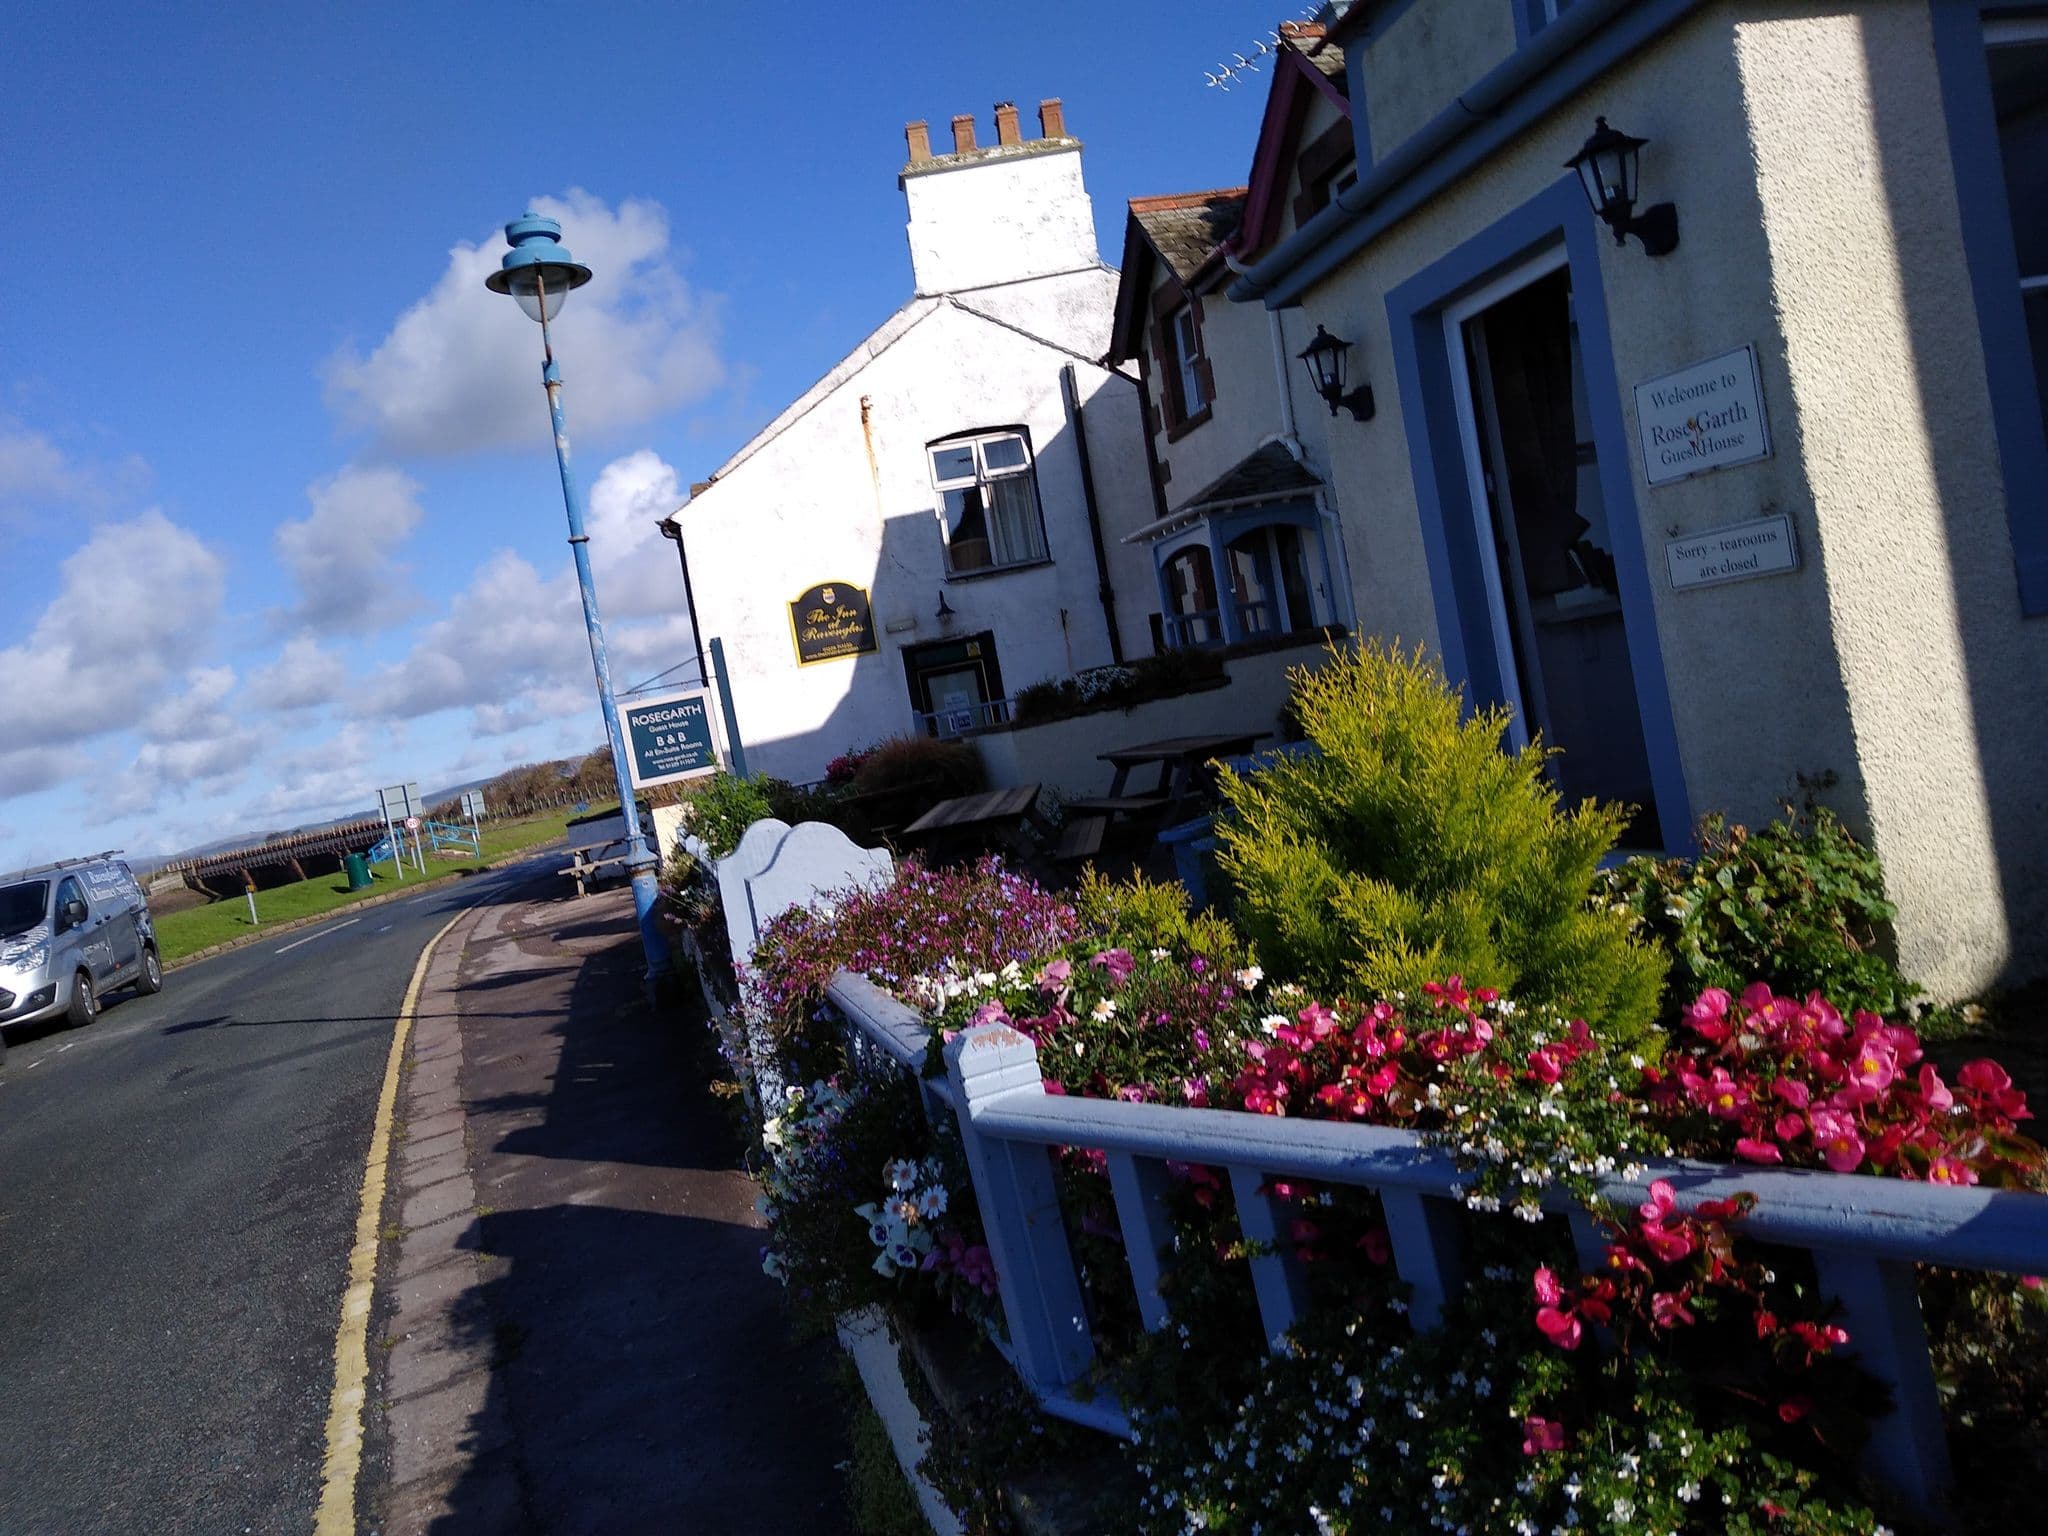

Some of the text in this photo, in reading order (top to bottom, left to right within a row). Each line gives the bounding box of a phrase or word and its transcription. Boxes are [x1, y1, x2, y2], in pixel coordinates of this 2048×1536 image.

[1651, 373, 1736, 409] Welcome to
[1651, 401, 1748, 447] Rose Garth
[1661, 432, 1744, 465] Guest House
[1675, 544, 1707, 560] Sorry
[1720, 529, 1777, 552] tearooms
[1700, 553, 1759, 578] are closed
[806, 604, 857, 624] The Inn
[827, 619, 840, 630] at
[802, 621, 866, 642] Ravenglas
[631, 704, 702, 727] ROSEGARTH
[649, 720, 689, 733] Guest House
[645, 749, 654, 758] All
[680, 741, 703, 750] Rooms
[656, 732, 686, 747] B & B
